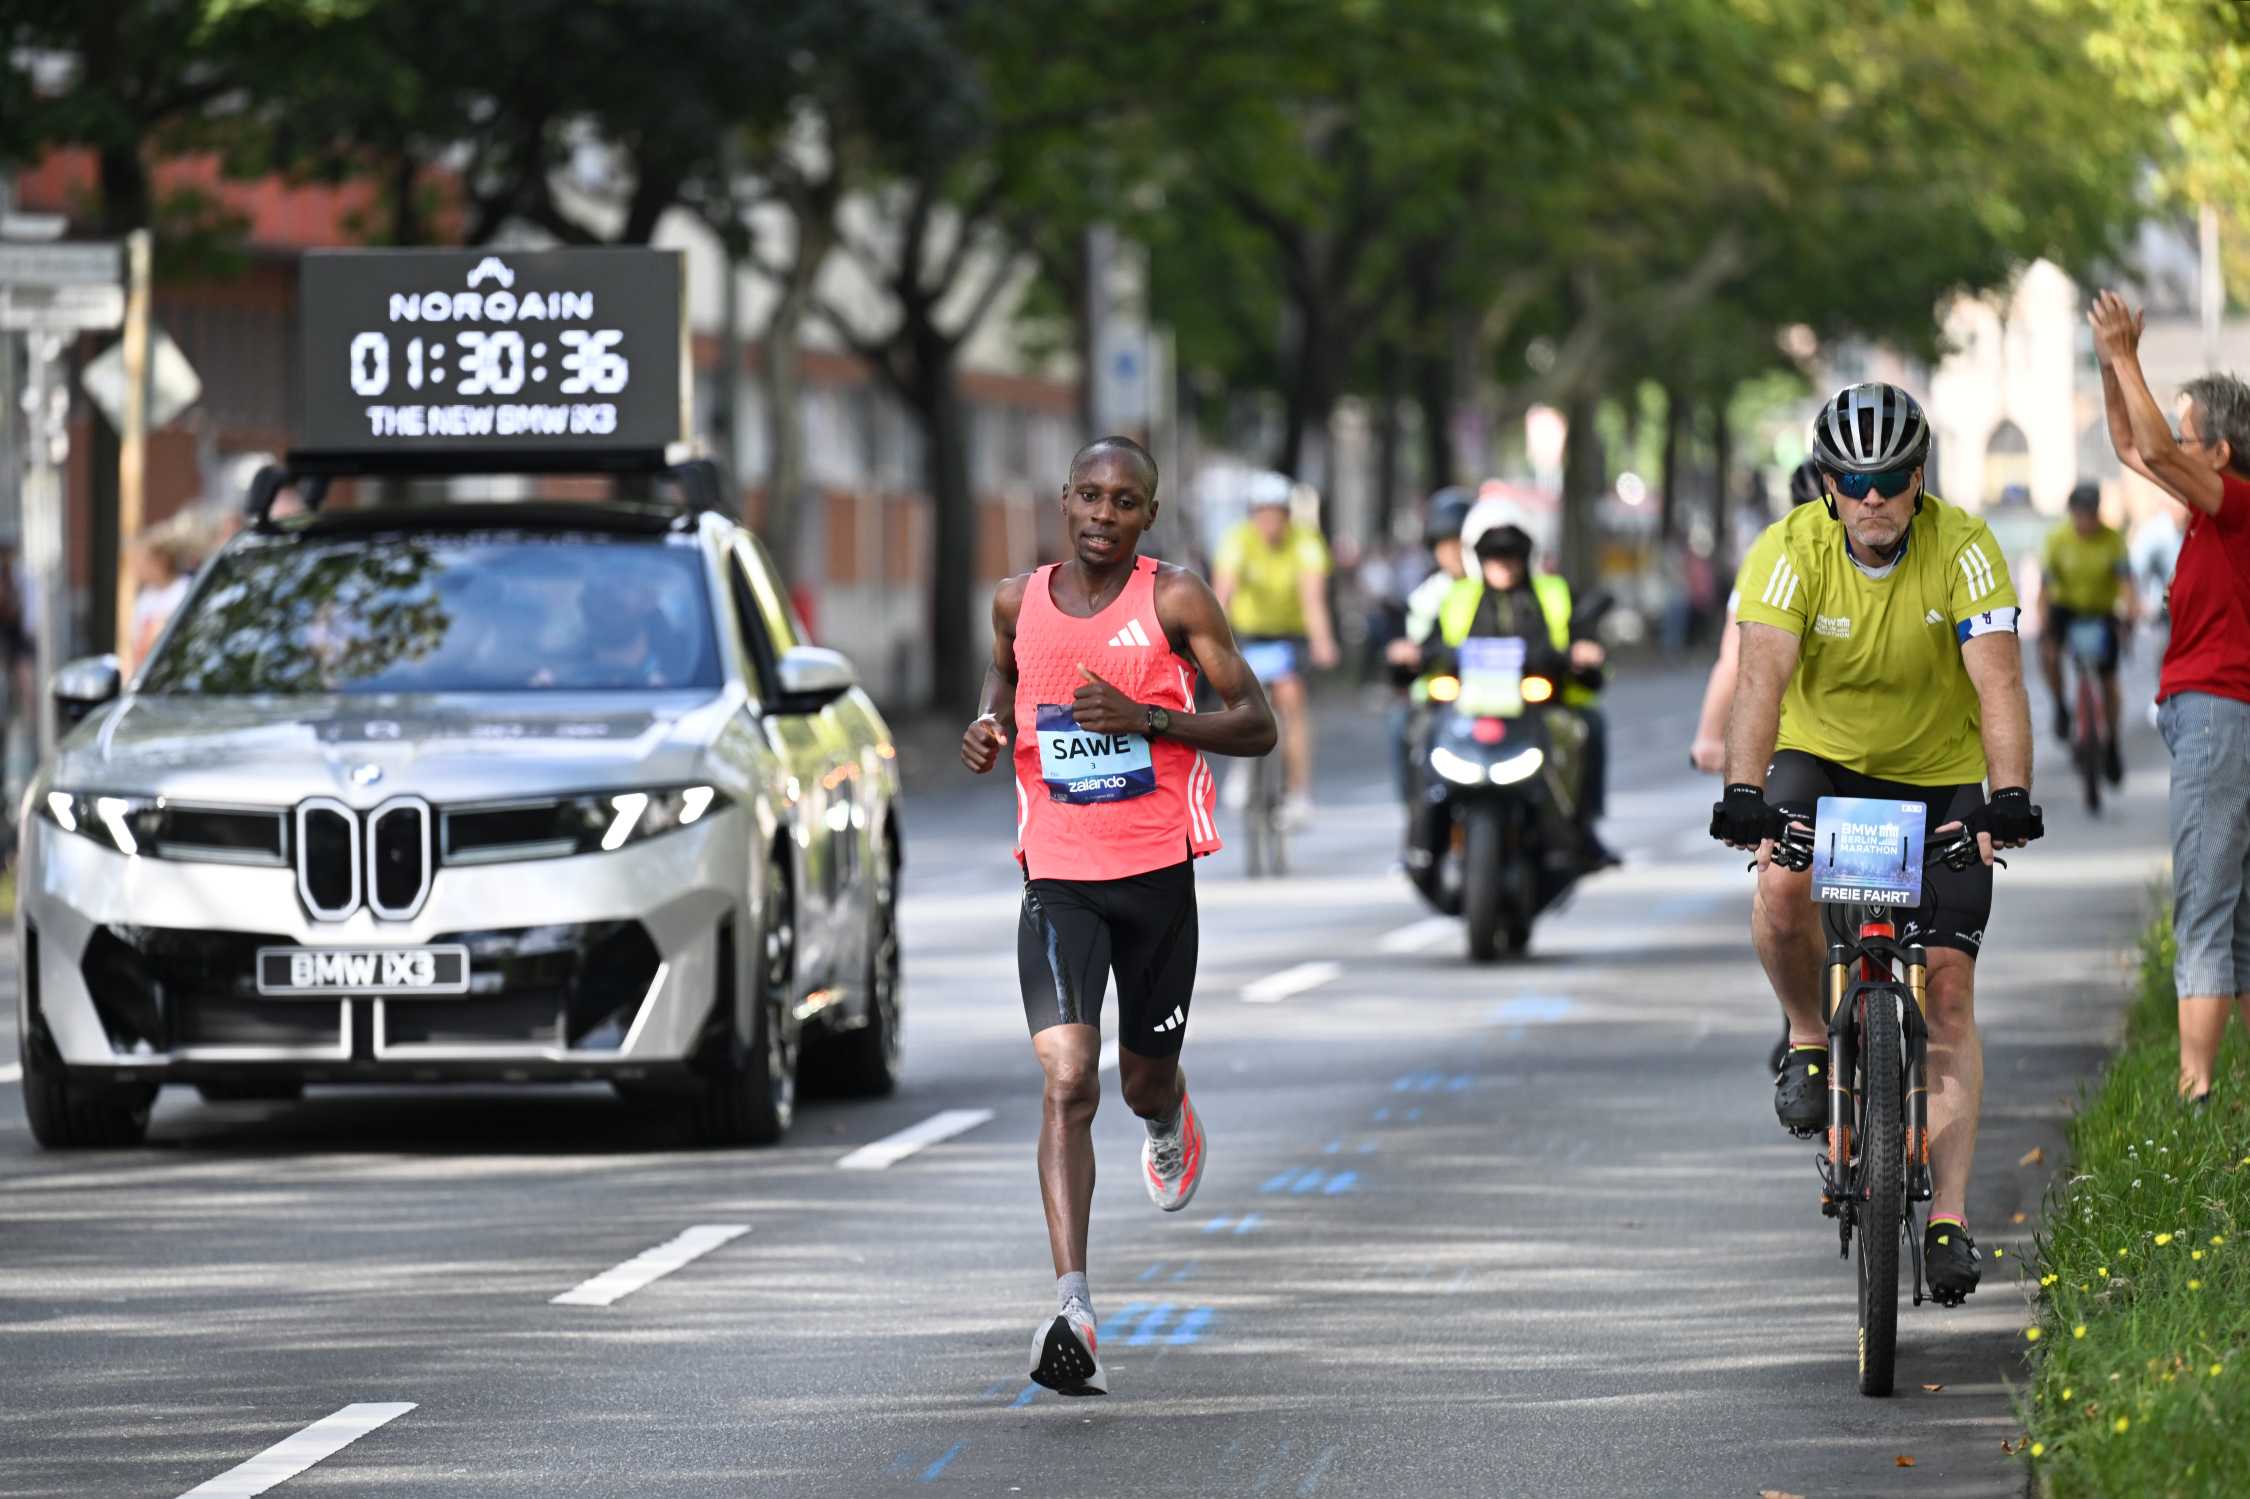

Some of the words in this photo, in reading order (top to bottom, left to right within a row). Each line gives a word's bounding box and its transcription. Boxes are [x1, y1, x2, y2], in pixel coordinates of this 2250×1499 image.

[389, 291, 594, 323] NORQAIN
[350, 329, 629, 396] 01:30:36
[366, 405, 426, 436] THE
[428, 405, 495, 436] NEW
[496, 404, 570, 435] BMW
[1053, 734, 1131, 760] SAWE
[1068, 776, 1127, 793] zalando
[1840, 835, 1878, 845] BERLIN
[1841, 823, 1878, 836] BMW
[1840, 844, 1898, 856] MARATHON
[1821, 886, 1862, 901] FREIE
[1863, 889, 1910, 904] FAHRT
[291, 952, 377, 987] BMW
